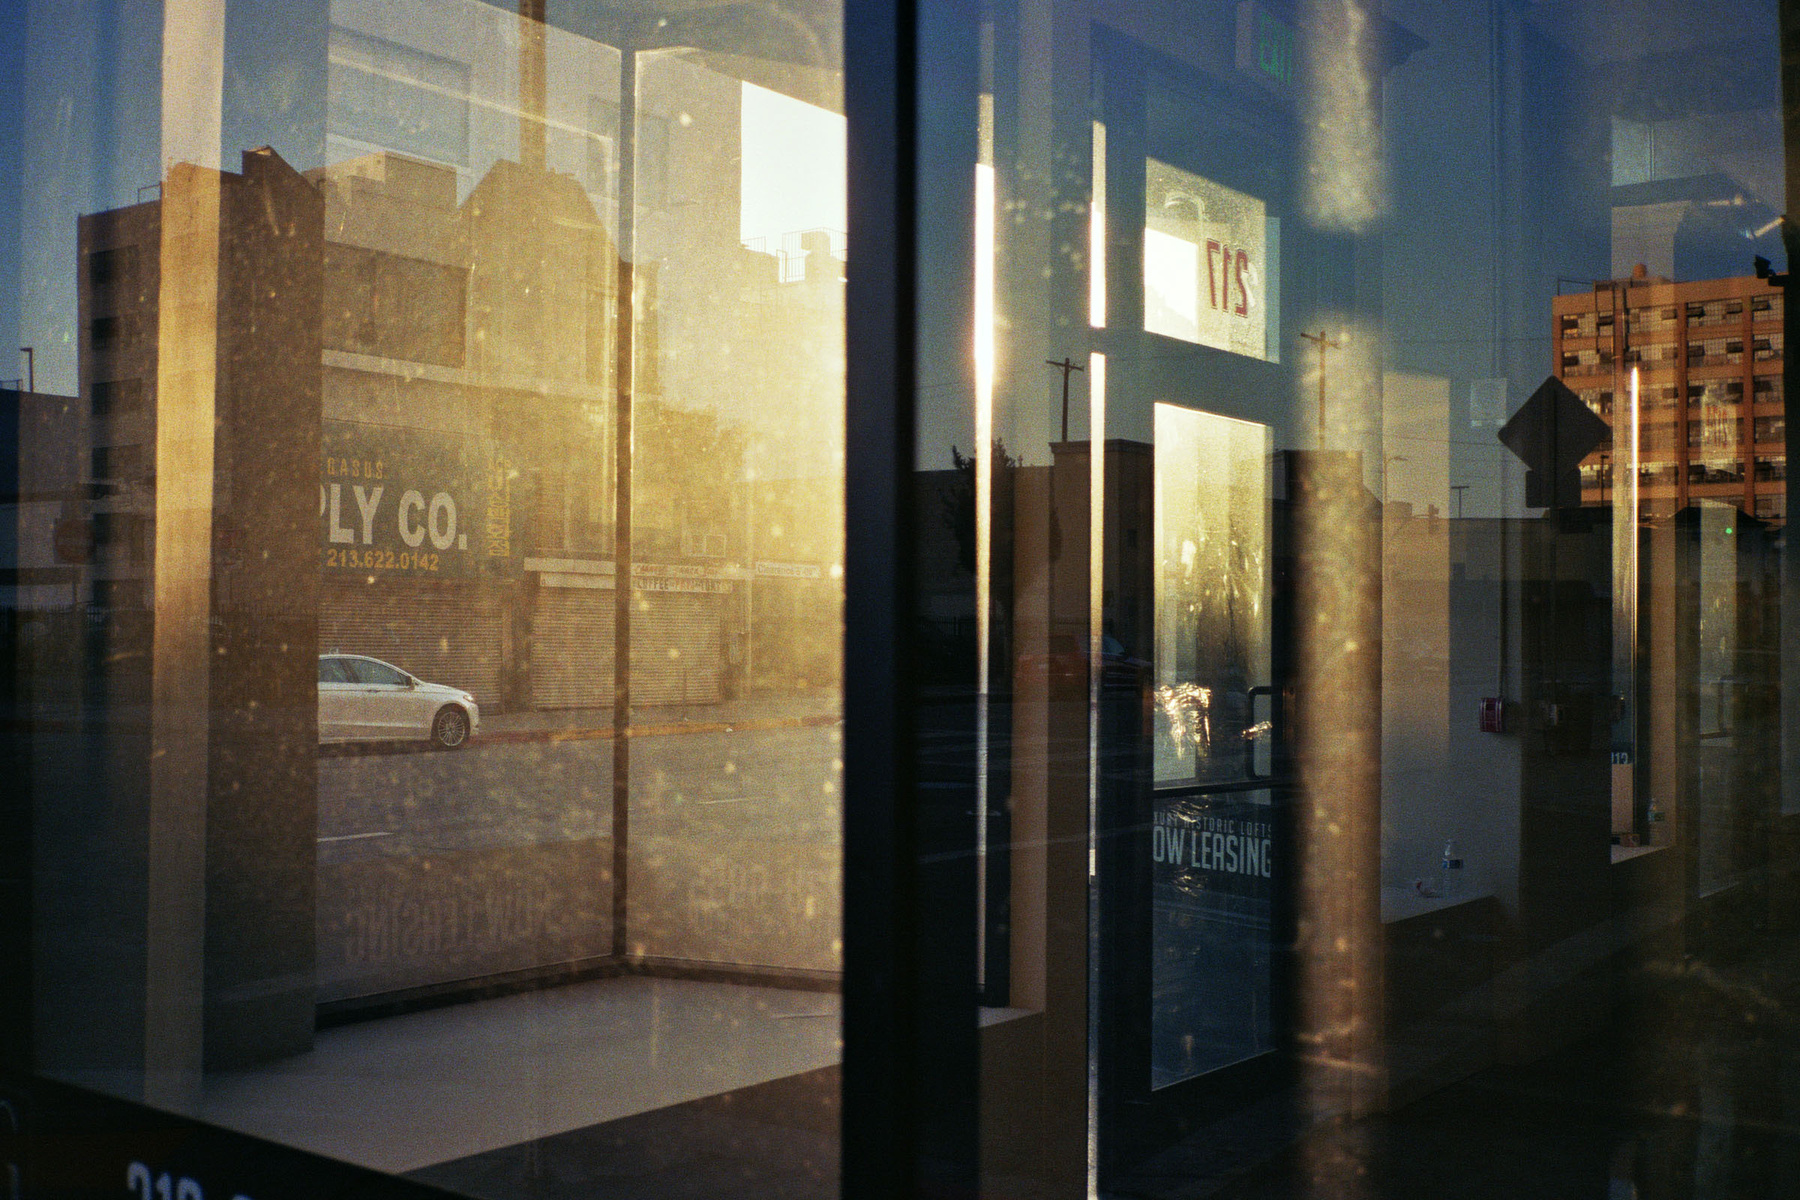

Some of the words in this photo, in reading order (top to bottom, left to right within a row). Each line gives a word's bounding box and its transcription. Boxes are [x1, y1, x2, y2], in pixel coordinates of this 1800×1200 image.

[320, 483, 384, 545] LY
[398, 489, 468, 550] CO.
[326, 549, 440, 572] 213.622.0142
[1191, 829, 1272, 878] LEASING
